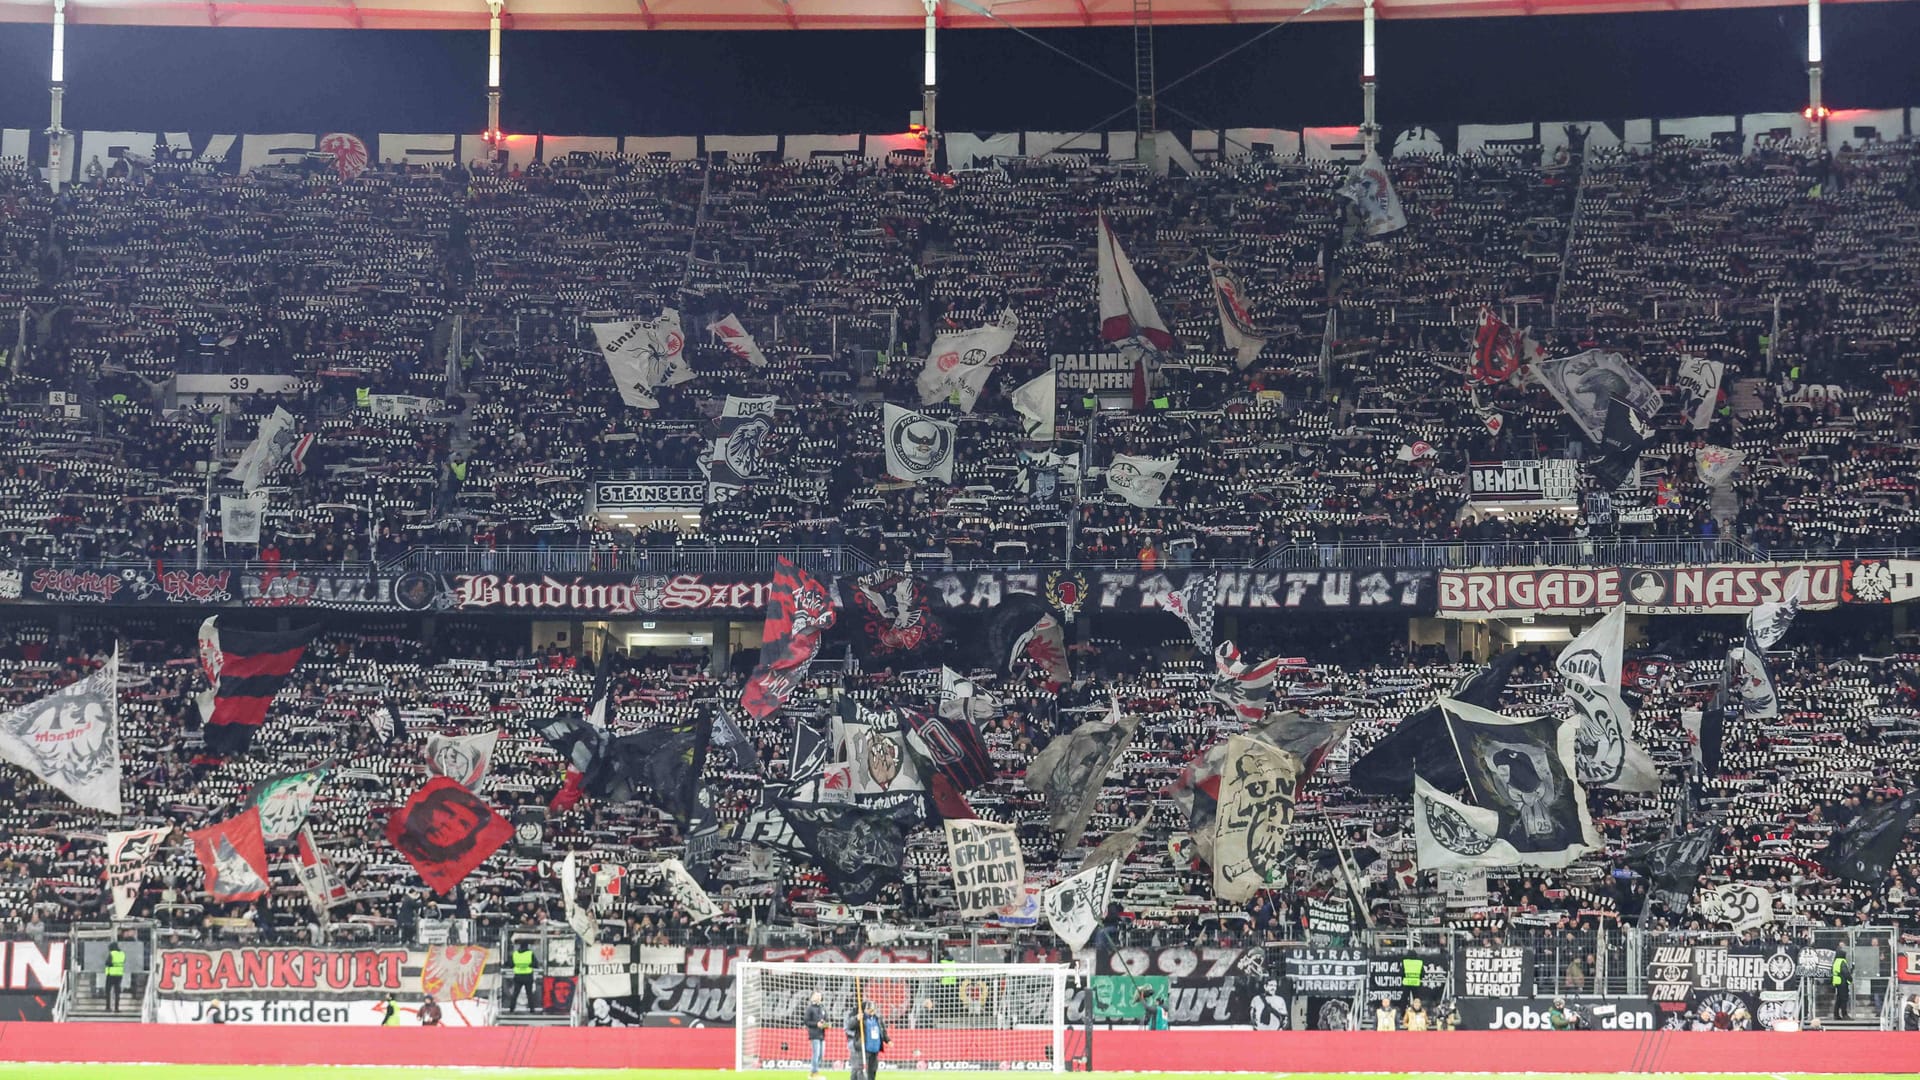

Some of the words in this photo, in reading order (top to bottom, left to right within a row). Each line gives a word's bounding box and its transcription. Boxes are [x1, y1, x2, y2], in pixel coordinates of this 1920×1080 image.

[229, 377, 249, 390] 39
[601, 485, 702, 502] STEINBERG
[163, 570, 231, 598] CREW
[454, 573, 636, 613] Binding
[661, 575, 775, 610] Szen
[1440, 572, 1622, 612] BRIGADE
[1309, 918, 1350, 933] FEIND
[1293, 949, 1361, 961] ULTRAS
[1653, 947, 1692, 962] FULDA
[159, 949, 407, 990] FRANKFURT
[588, 963, 625, 975] NUOVA
[1299, 964, 1356, 976] NEVER
[1466, 958, 1522, 972] GRUPPE
[1728, 957, 1765, 977] RIED
[1466, 971, 1522, 983] STADION
[1726, 977, 1765, 991] GEBIET
[1466, 983, 1519, 997] VERBOT
[1651, 984, 1689, 1000] CREW
[192, 1001, 250, 1023] Jbs
[260, 1000, 349, 1023] finden
[1489, 1005, 1551, 1030] Jobs
